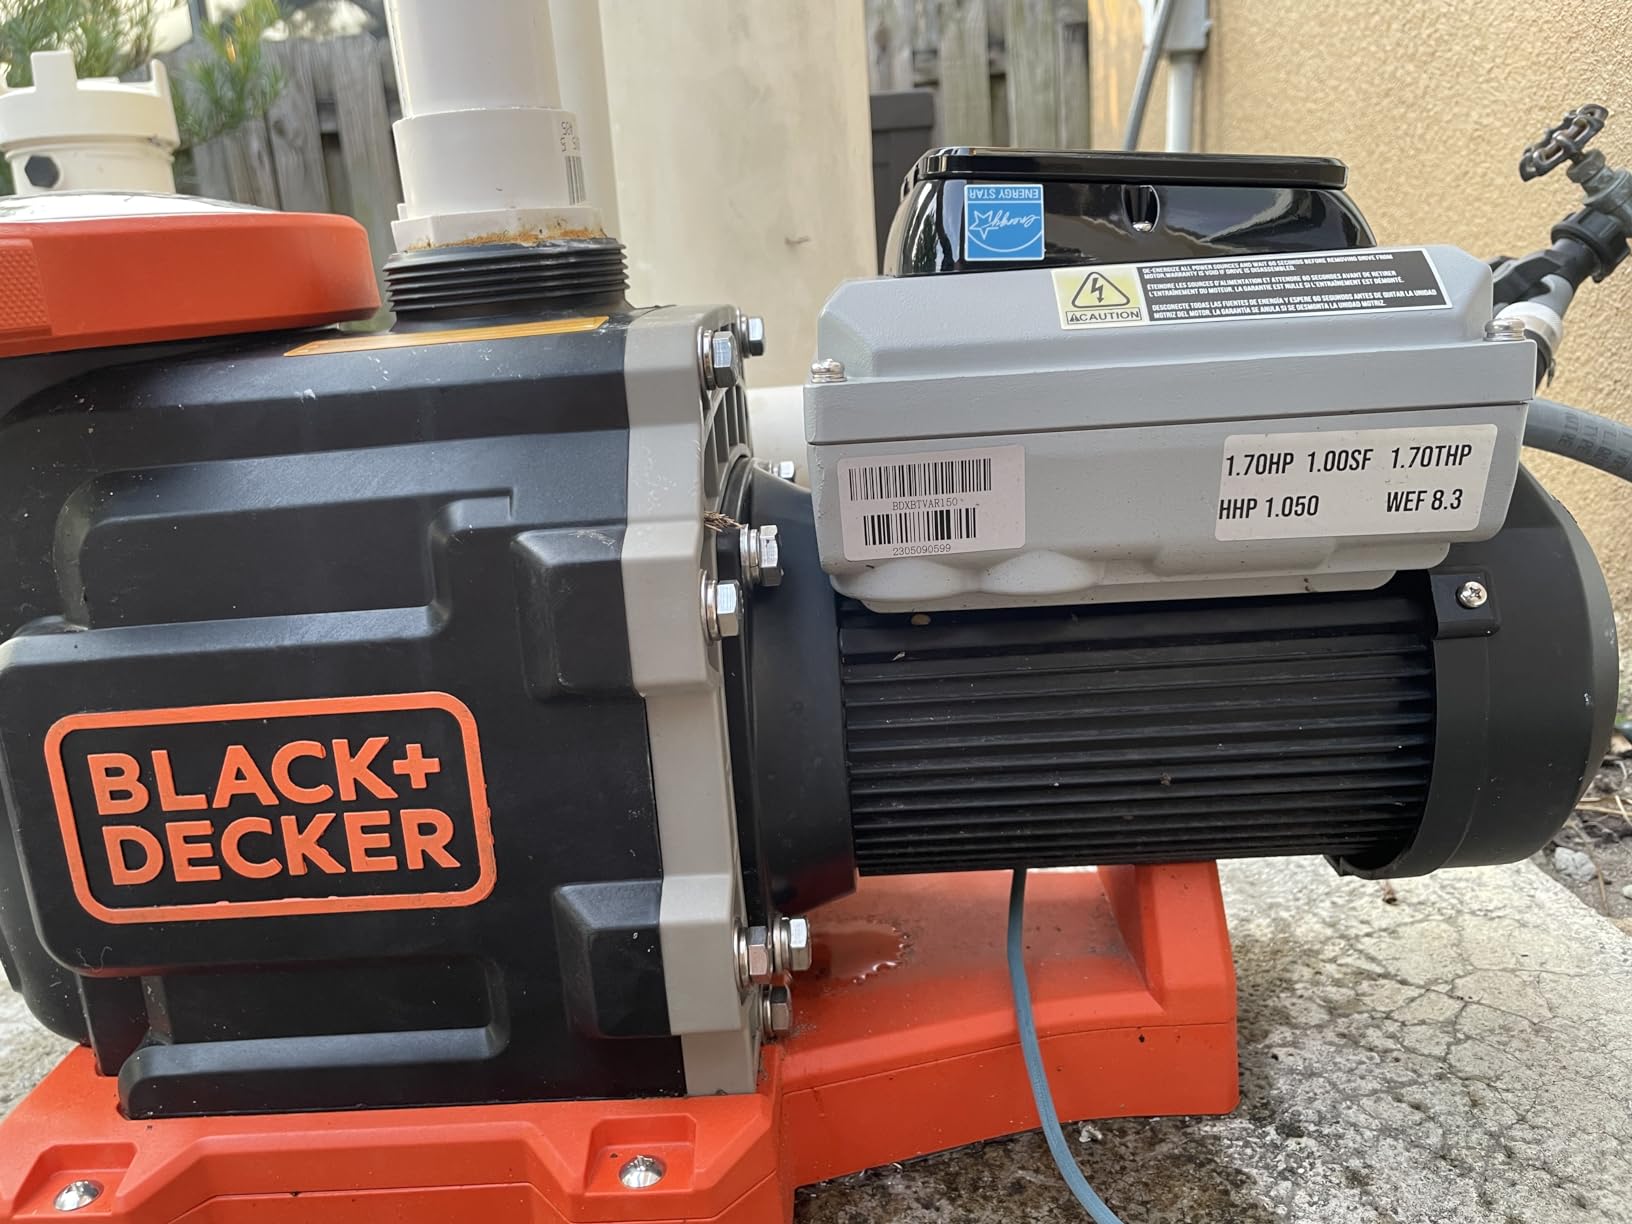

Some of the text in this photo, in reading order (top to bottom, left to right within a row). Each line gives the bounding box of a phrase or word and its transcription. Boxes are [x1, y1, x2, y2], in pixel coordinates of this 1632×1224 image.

[969, 188, 1039, 198] ENERGY STAR
[988, 209, 1040, 228] energy
[1079, 311, 1139, 322] CAUTION
[1225, 444, 1472, 476] 1.70HP 1.00SF 1.70THP
[892, 497, 958, 510] BDXBTVAR150
[1218, 489, 1463, 520] HHP 1.050 WEF 8.3
[892, 544, 952, 556] 2305090599
[87, 736, 440, 816] BLACK+
[101, 808, 462, 886] DECKER
